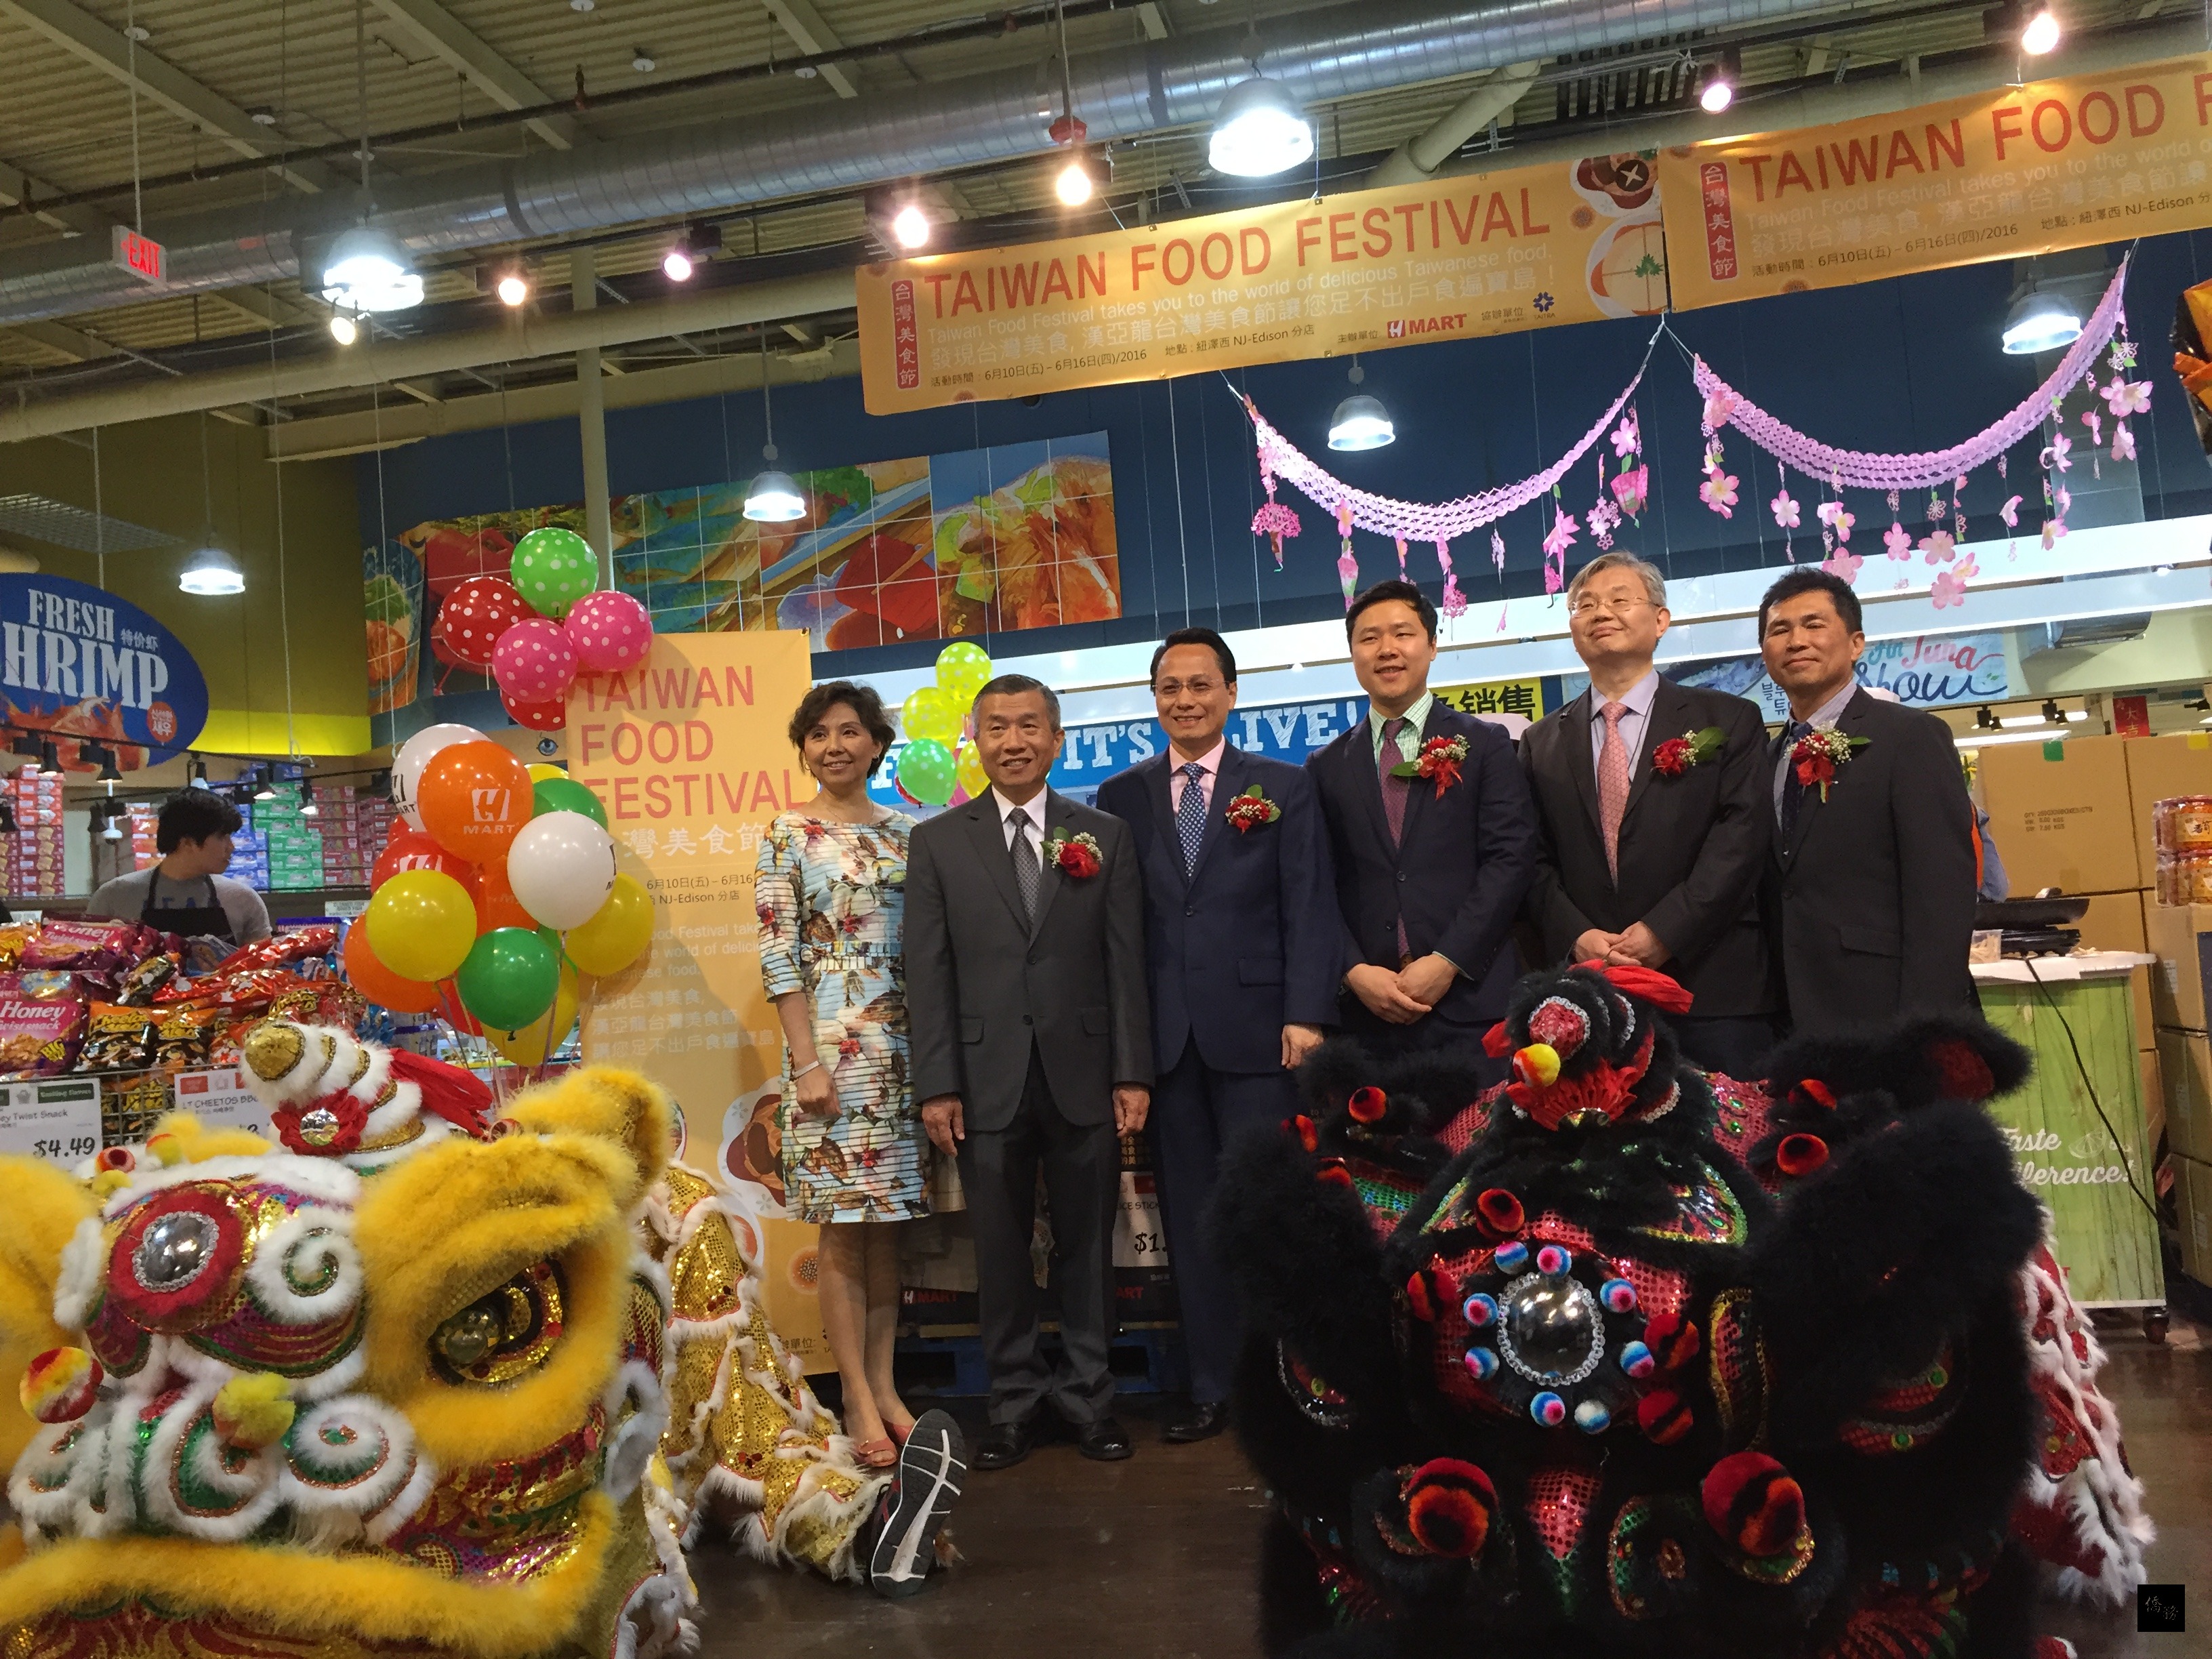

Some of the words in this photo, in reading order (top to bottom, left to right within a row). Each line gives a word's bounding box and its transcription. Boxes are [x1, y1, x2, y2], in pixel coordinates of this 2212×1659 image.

[1739, 119, 1965, 201] TAIWAN
[1992, 85, 2165, 161] FOOD
[1746, 205, 1813, 230] Taiwan
[1822, 196, 1868, 216] Food
[1877, 178, 1951, 205] Festival
[1960, 172, 2016, 194] takes
[2023, 165, 2059, 188] you
[2068, 159, 2087, 175] to
[2095, 152, 2127, 169] the
[2135, 139, 2190, 164] world
[1704, 165, 1734, 276] 台灣美食節
[128, 232, 161, 279] EXIT
[924, 251, 1106, 319] TAIWAN
[1132, 227, 1271, 291] FOOD
[1296, 188, 1550, 266] FESTIVAL
[928, 325, 981, 344] Taiwan
[989, 315, 1026, 335] Food
[1033, 305, 1094, 327] Festival
[1101, 301, 1146, 320] takes
[1153, 297, 1181, 316] you
[1187, 292, 1204, 307] to
[1212, 288, 1238, 304] the
[1246, 278, 1290, 299] world
[1297, 274, 1313, 290] of
[1320, 266, 1397, 289] delicious
[1404, 252, 1499, 277] Taiwanese
[1507, 243, 1552, 264] food.
[895, 283, 917, 386] 台灣美食節
[1409, 314, 1467, 334] MART
[1233, 330, 1288, 346] NJ-Edison
[28, 588, 115, 642] FRESH
[2, 621, 169, 710] HRIMP
[577, 665, 754, 712] TAIWAN
[581, 720, 714, 766] FOOD
[1063, 722, 1155, 771] IT'S
[1232, 701, 1357, 752] IVE!
[464, 825, 515, 834] MART
[622, 821, 766, 859] 灣美食節
[659, 894, 714, 904] NJ-Edison
[652, 928, 674, 941] ood
[679, 924, 729, 939] Festival
[733, 922, 759, 935] take
[665, 944, 699, 958] world
[704, 943, 717, 956] of
[722, 941, 760, 954] delici
[668, 963, 701, 976] food.
[0, 1000, 66, 1021] Honey
[26, 1020, 61, 1030] snack
[41, 1109, 68, 1119] Snack
[194, 1096, 239, 1109] CHEETOS
[33, 1136, 95, 1159] $4.49
[2015, 1159, 2134, 1189] ference!
[1134, 1231, 1166, 1255] $1.
[1116, 1286, 1144, 1299] ART
